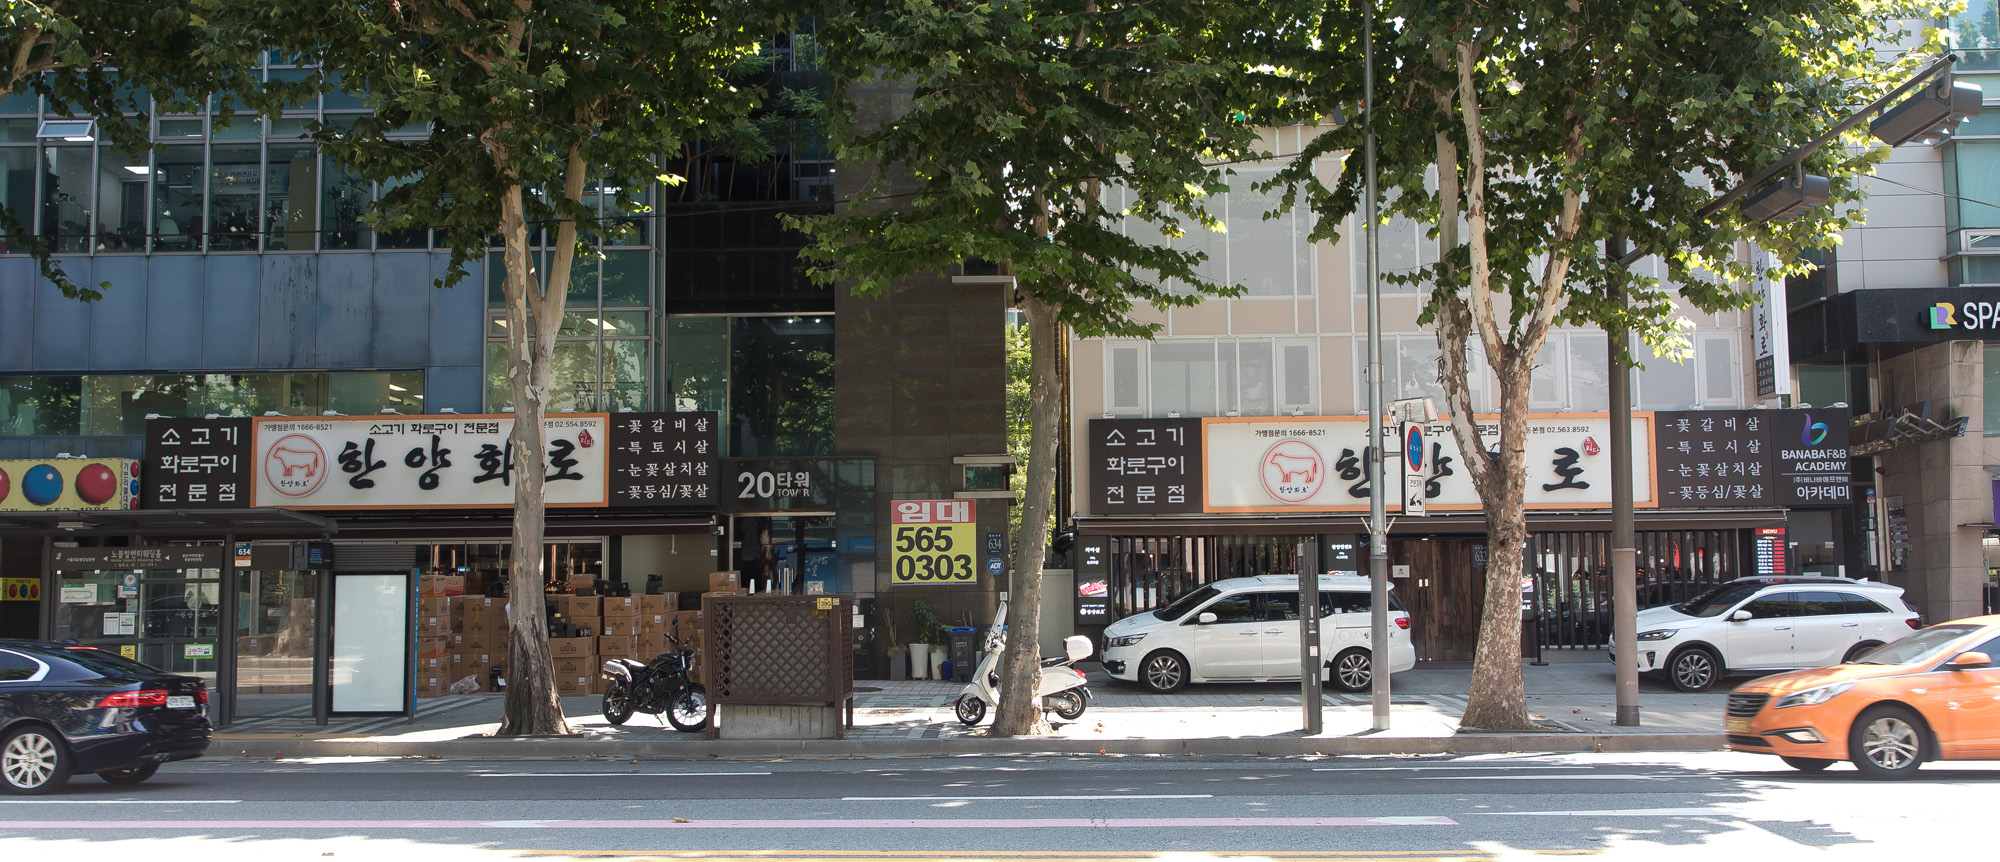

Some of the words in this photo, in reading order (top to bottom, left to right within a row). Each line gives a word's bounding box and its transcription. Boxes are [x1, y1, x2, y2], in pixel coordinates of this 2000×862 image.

[161, 427, 238, 446] 소고기
[264, 424, 296, 432] 가맹점문의
[297, 423, 333, 431] 1666-8521
[369, 424, 405, 435] 소고기
[410, 422, 458, 435] 화로구이
[463, 422, 499, 434] 전문점
[1106, 427, 1184, 446] 소고기
[1255, 430, 1287, 438] 가맹점문의
[1289, 429, 1326, 437] 1666-8521
[1475, 424, 1499, 436] 문점
[160, 454, 237, 474] 화로구이
[337, 434, 584, 490] 한양화로
[1106, 456, 1184, 475] 화로구이
[1335, 441, 1590, 498] 한양로
[1795, 462, 1847, 471] ACADEMY
[159, 483, 236, 502] 전문점
[777, 488, 810, 497] TOWR
[1106, 484, 1185, 504] 전문점
[1796, 485, 1850, 500] 아카데미
[897, 502, 969, 523] 임대
[895, 526, 953, 552] 565
[988, 538, 1001, 549] 634
[896, 554, 973, 581] 0303
